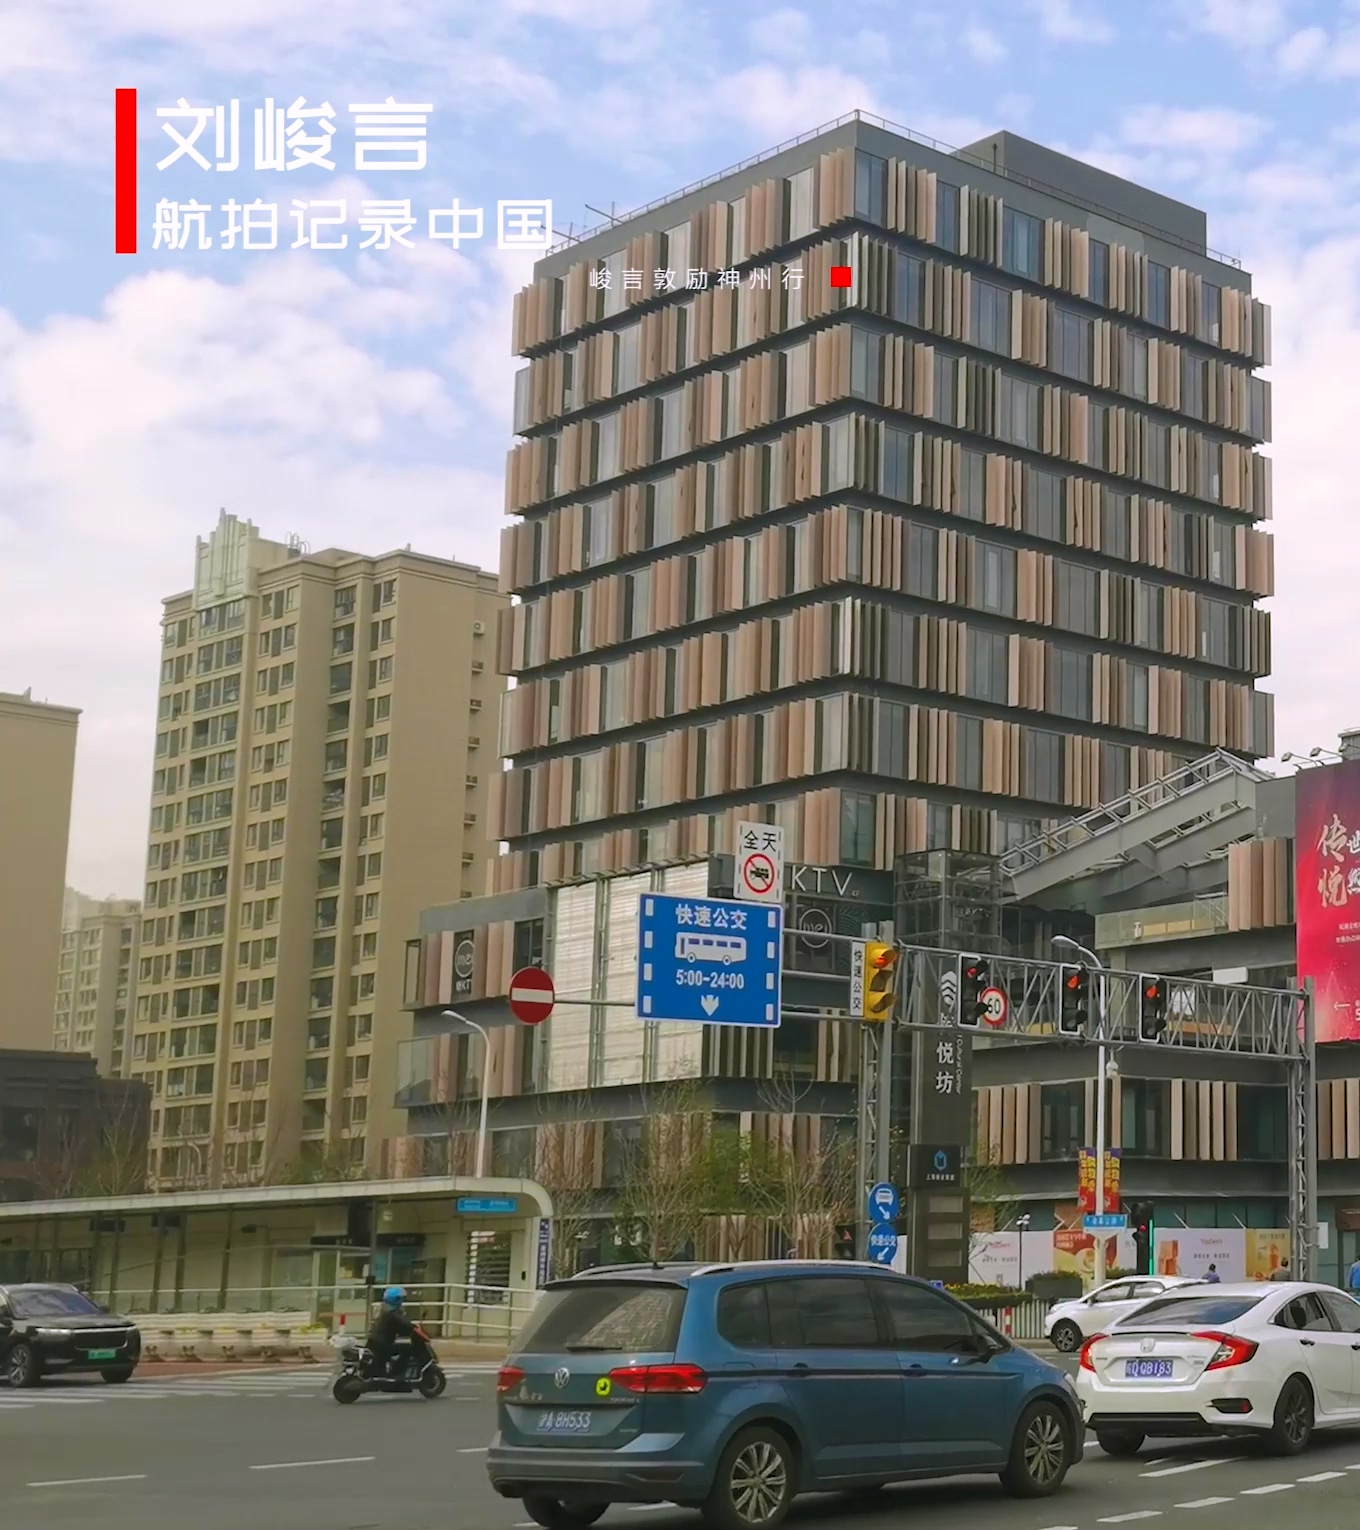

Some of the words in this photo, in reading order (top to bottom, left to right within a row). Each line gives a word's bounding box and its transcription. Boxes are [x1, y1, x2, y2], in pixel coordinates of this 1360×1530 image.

[743, 830, 777, 852] 全天
[791, 864, 852, 896] KTV
[675, 903, 748, 931] 快速公交
[675, 968, 745, 990] 5:00-24:00
[852, 949, 862, 1010] 快速公交
[987, 998, 1001, 1015] 60
